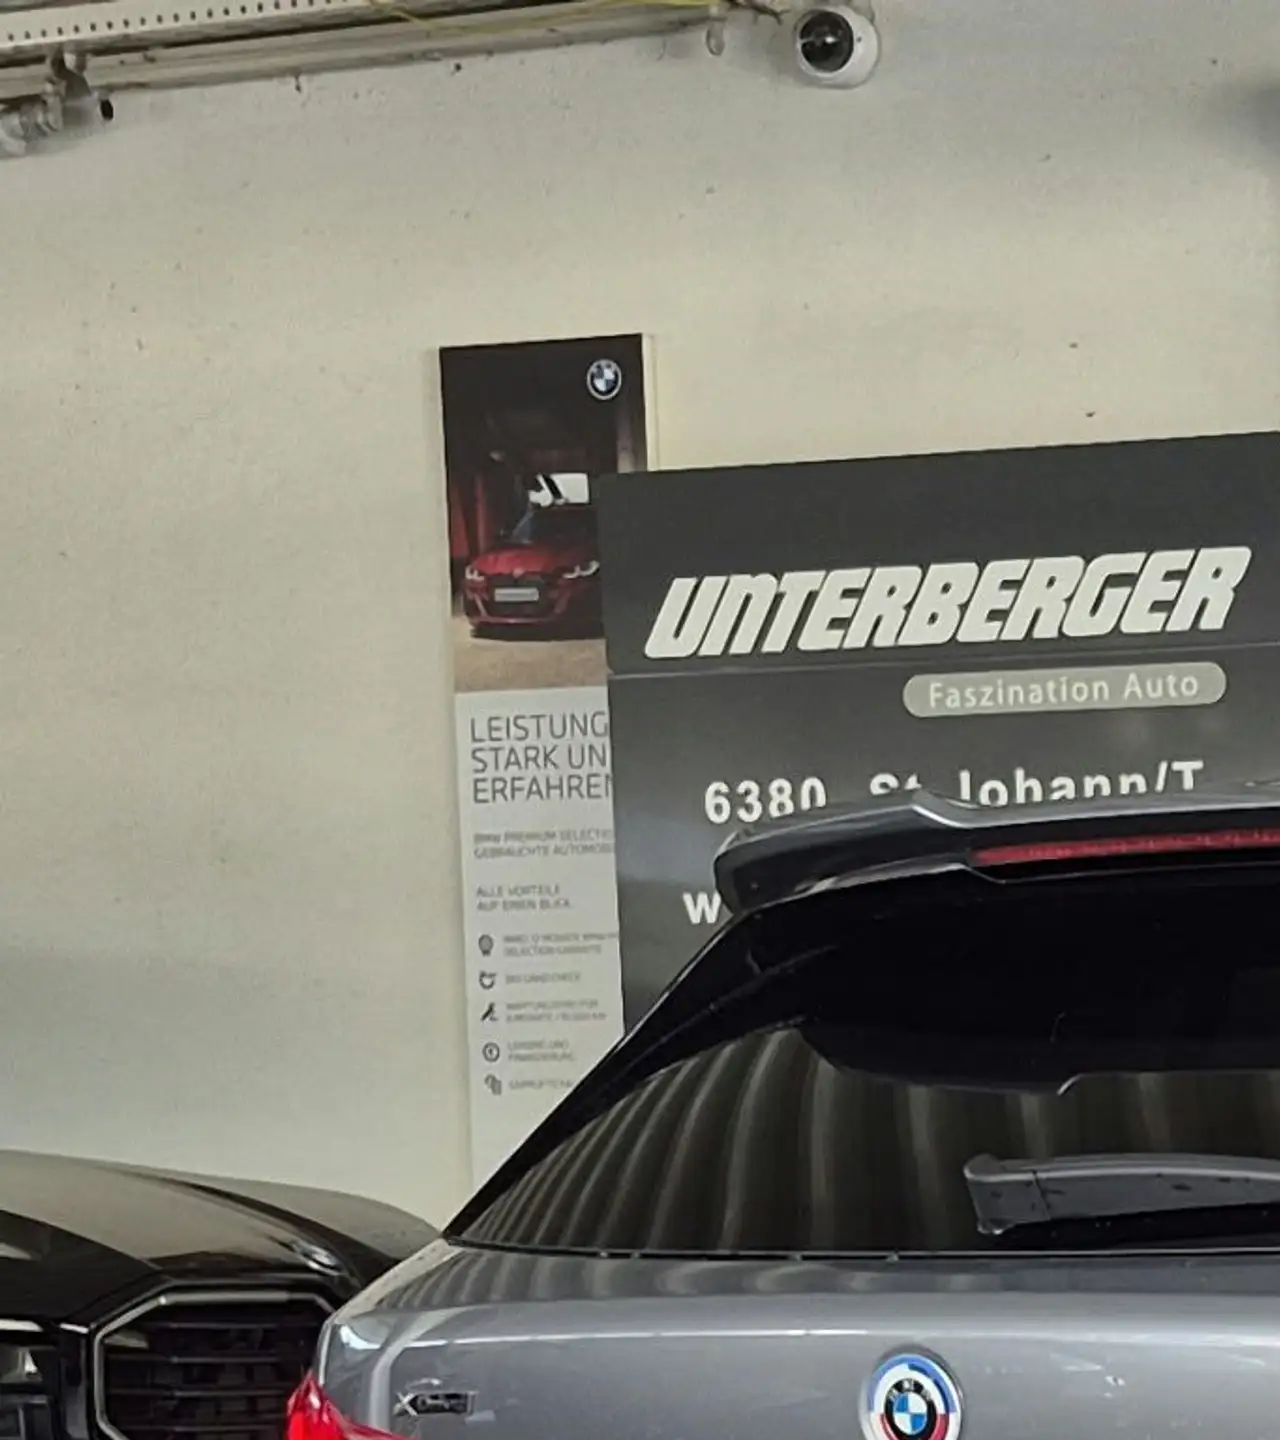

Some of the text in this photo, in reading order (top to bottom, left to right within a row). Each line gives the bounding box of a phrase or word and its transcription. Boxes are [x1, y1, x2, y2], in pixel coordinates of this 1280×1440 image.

[643, 546, 1253, 660] UNTERBERGER
[928, 671, 1199, 709] Faszination Auto
[471, 744, 560, 774] STARK
[704, 776, 827, 824] 6380
